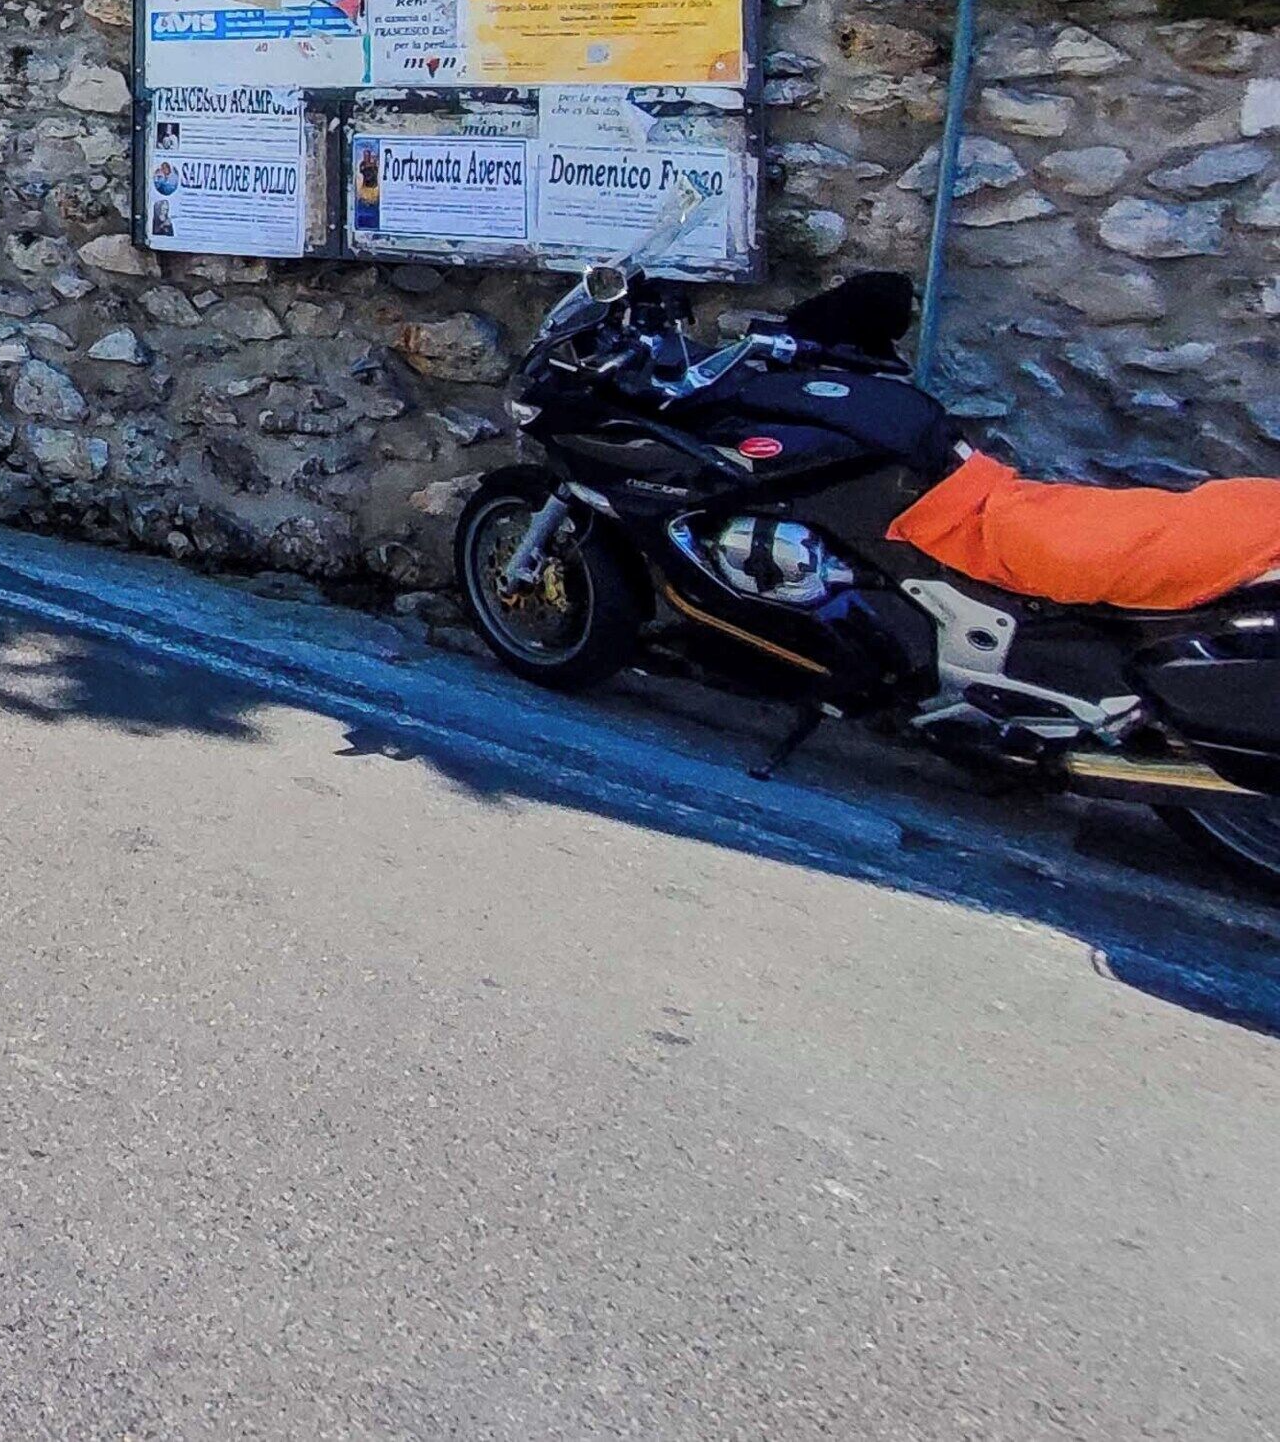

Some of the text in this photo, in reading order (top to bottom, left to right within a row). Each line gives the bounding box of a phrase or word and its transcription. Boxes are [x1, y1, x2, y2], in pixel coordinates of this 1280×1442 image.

[156, 86, 227, 113] FRANCESCO
[181, 162, 297, 195] SALVATORE POLLIO
[383, 148, 522, 185] Fortunata Aversa
[549, 154, 651, 189] Domenico
